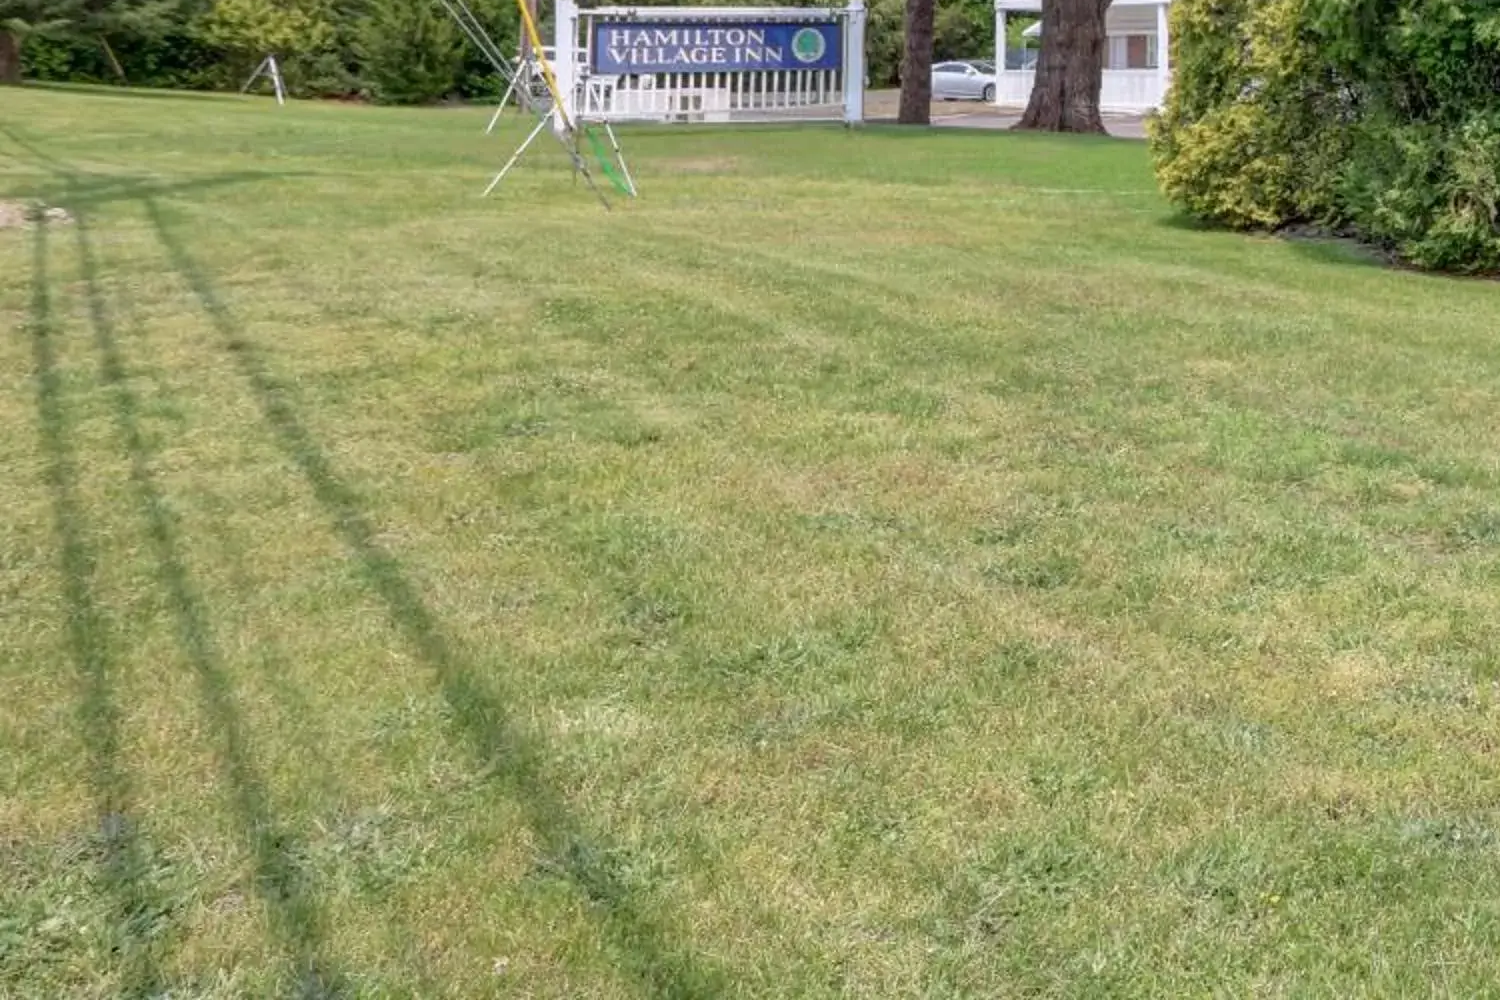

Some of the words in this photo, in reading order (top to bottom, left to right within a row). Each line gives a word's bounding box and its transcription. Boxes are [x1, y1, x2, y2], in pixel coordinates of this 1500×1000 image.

[610, 28, 766, 46] HAMILTON
[606, 48, 727, 65] VILLAGE
[733, 47, 784, 63] INN
